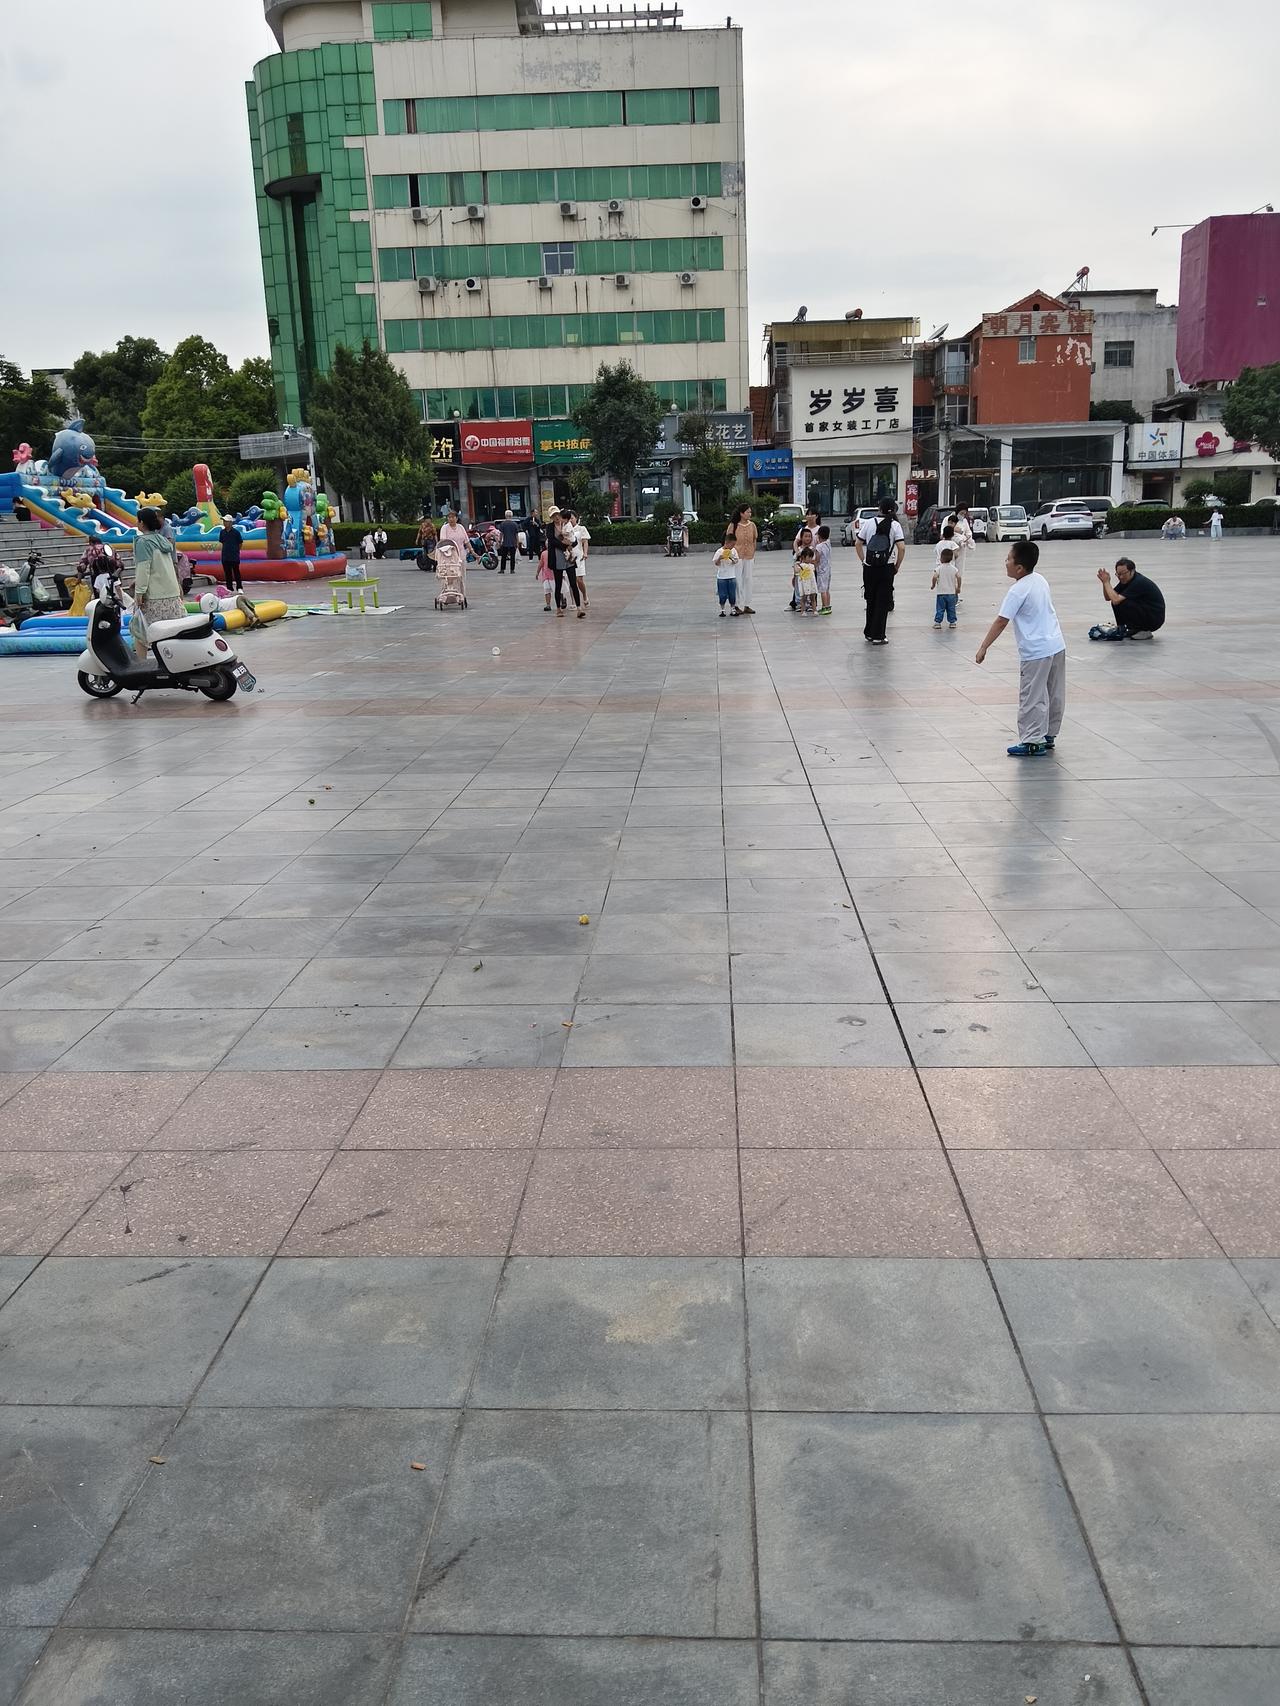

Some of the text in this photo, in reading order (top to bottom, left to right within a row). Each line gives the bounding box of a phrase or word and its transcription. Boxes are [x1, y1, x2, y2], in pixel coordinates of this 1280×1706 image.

[809, 386, 898, 415] 岁岁喜
[805, 418, 899, 432] 首家女装工厂店
[1138, 449, 1178, 460] 中国体彩
[911, 470, 937, 478] 明月
[907, 484, 918, 511] 宾馆
